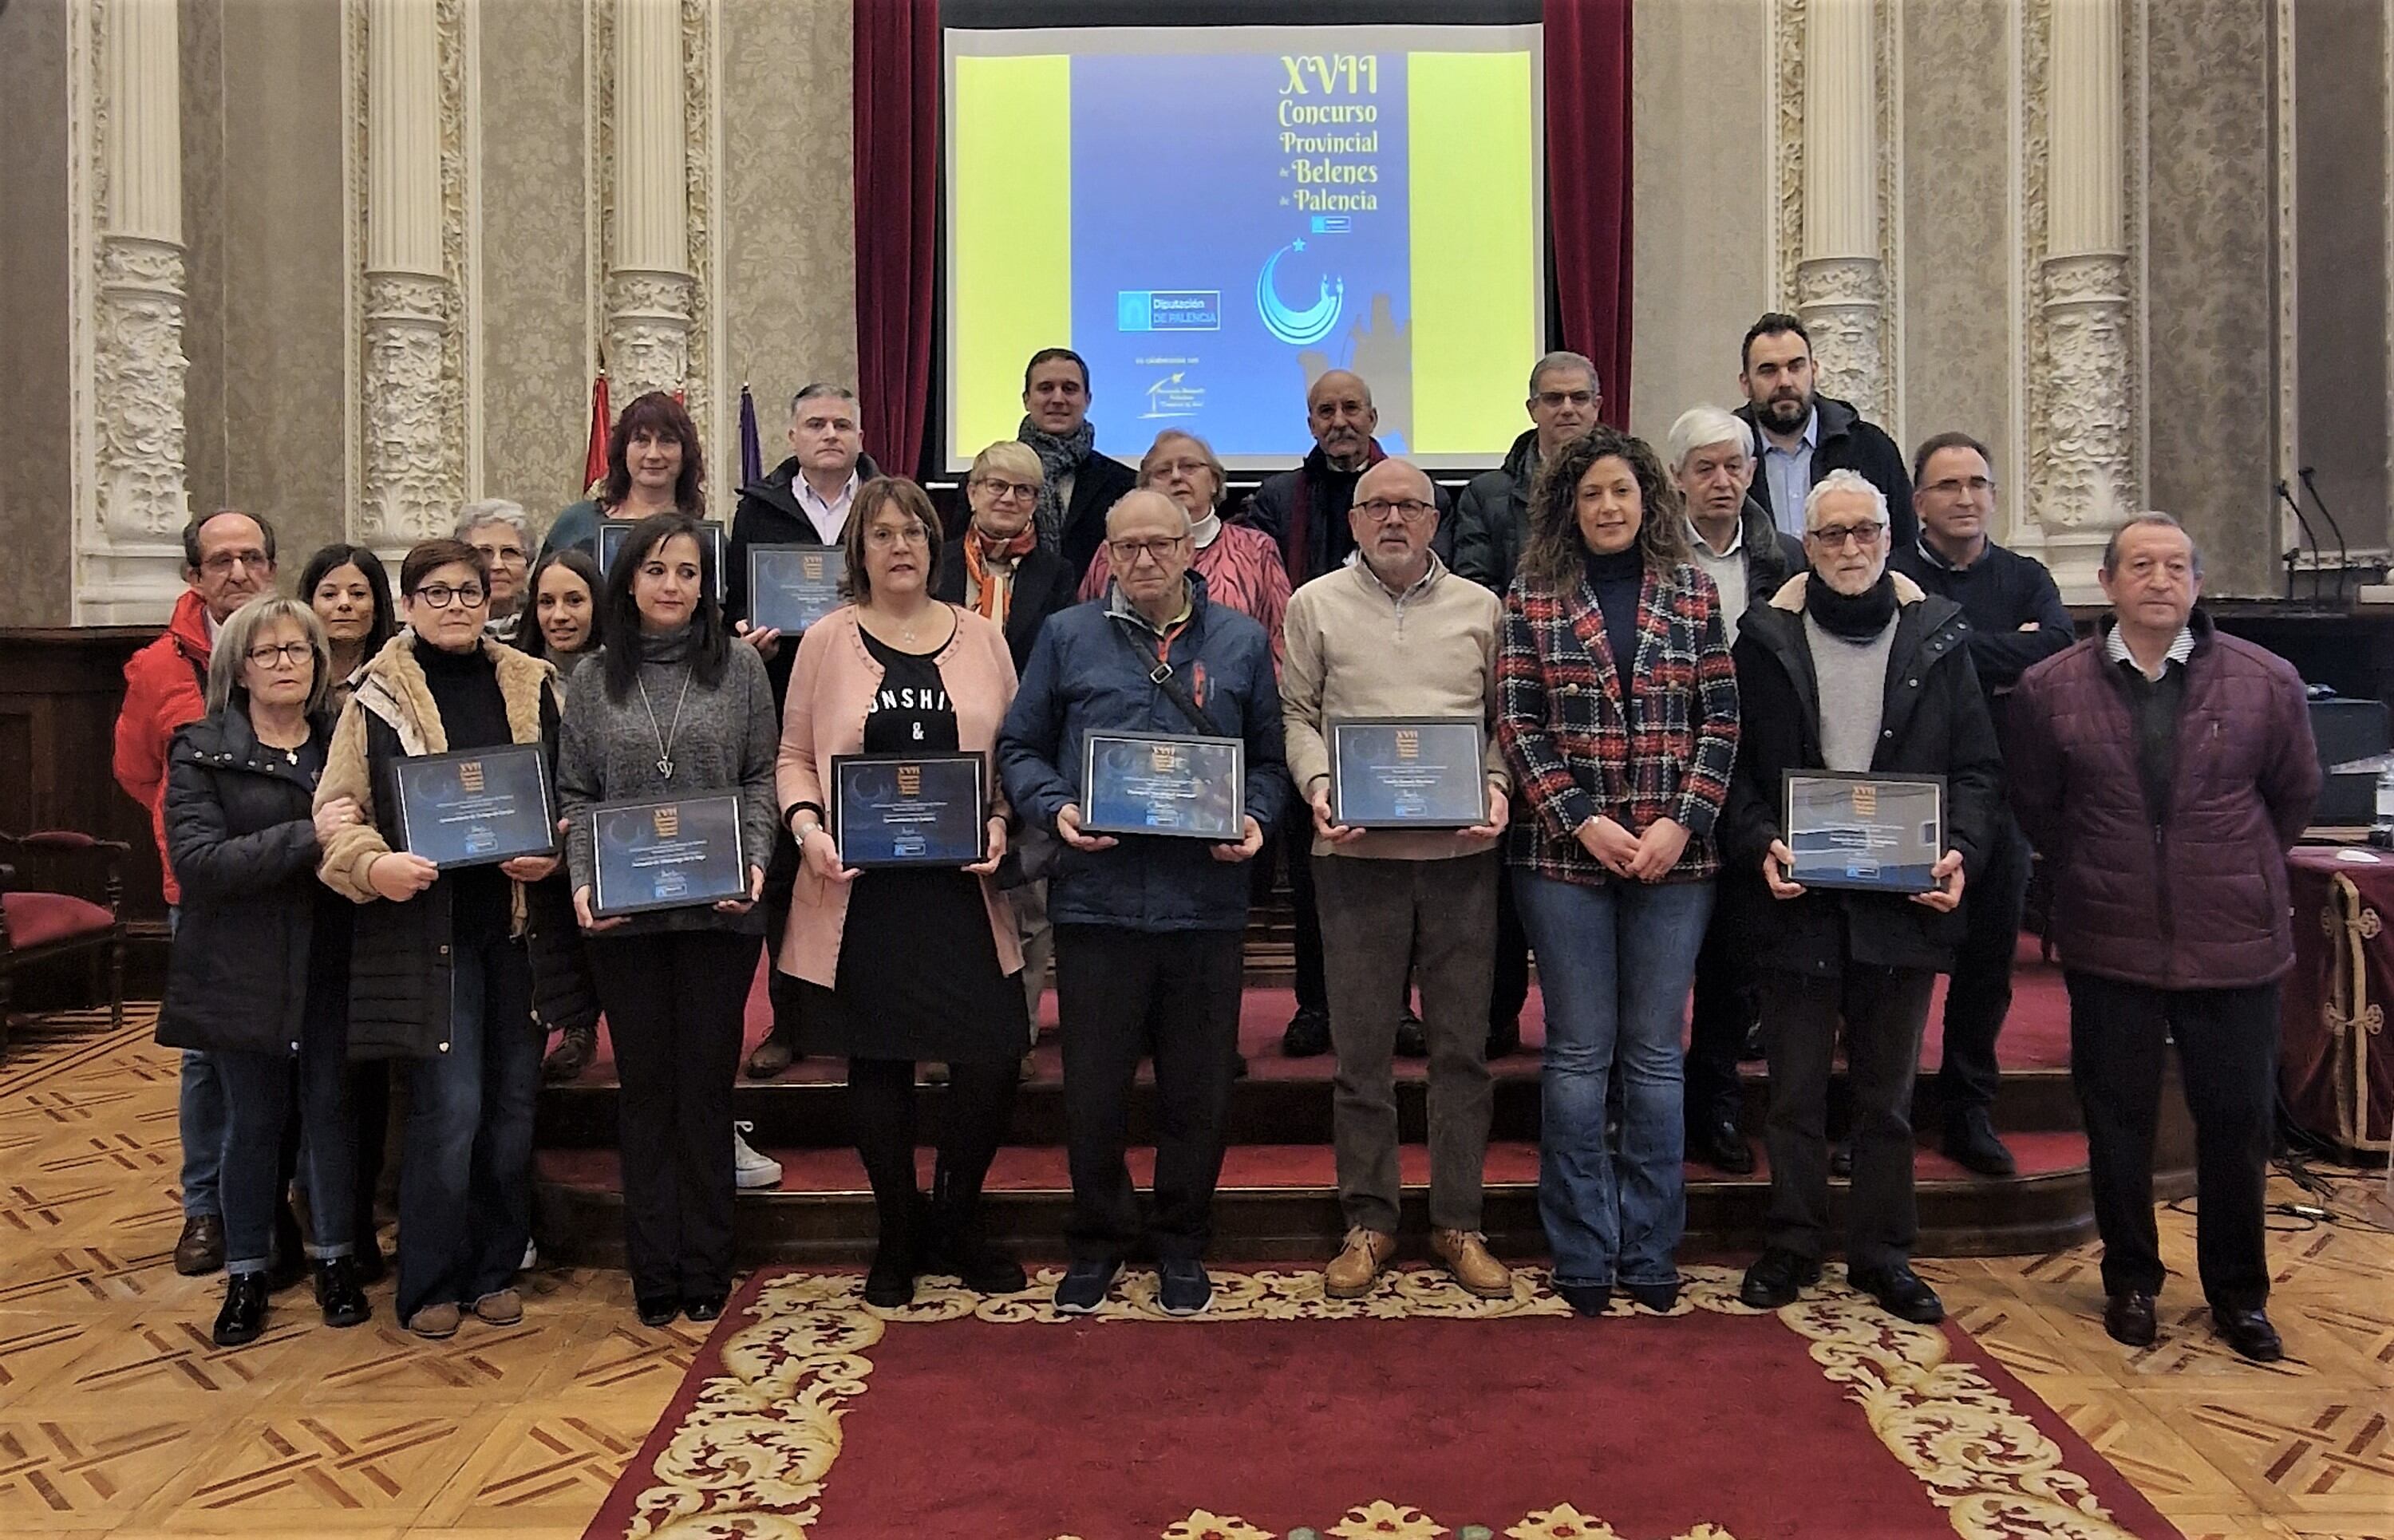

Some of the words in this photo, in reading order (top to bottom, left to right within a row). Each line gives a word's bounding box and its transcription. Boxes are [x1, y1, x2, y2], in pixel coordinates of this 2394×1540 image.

[1278, 53, 1377, 94] XVII
[1278, 99, 1377, 127] Concurso
[1279, 130, 1378, 153] Provincial
[1291, 157, 1378, 184] Belenes
[1293, 188, 1378, 211] Palencia
[912, 721, 925, 740] &
